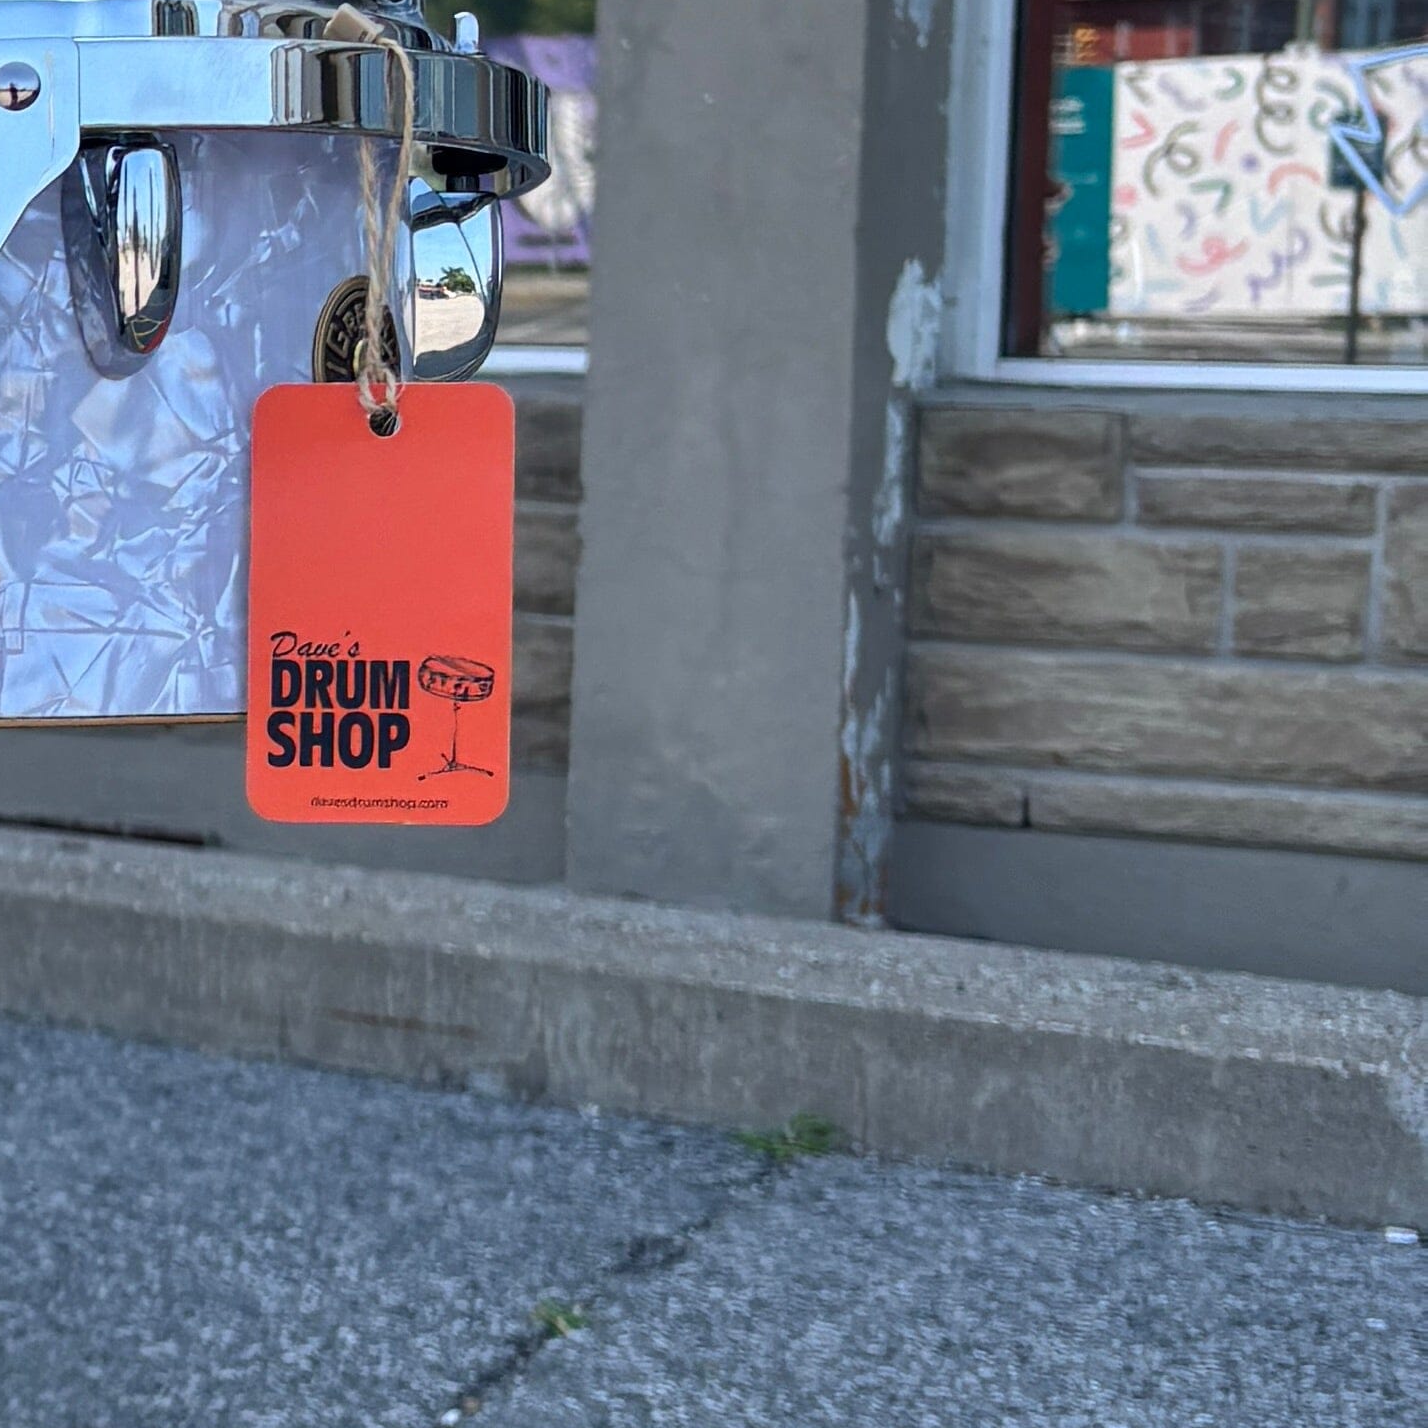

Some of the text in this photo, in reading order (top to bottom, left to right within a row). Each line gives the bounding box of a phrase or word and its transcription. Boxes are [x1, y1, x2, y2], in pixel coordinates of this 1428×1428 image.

[270, 630, 360, 658] Dave's
[270, 658, 411, 710] DRUM
[266, 710, 411, 769] SHOP
